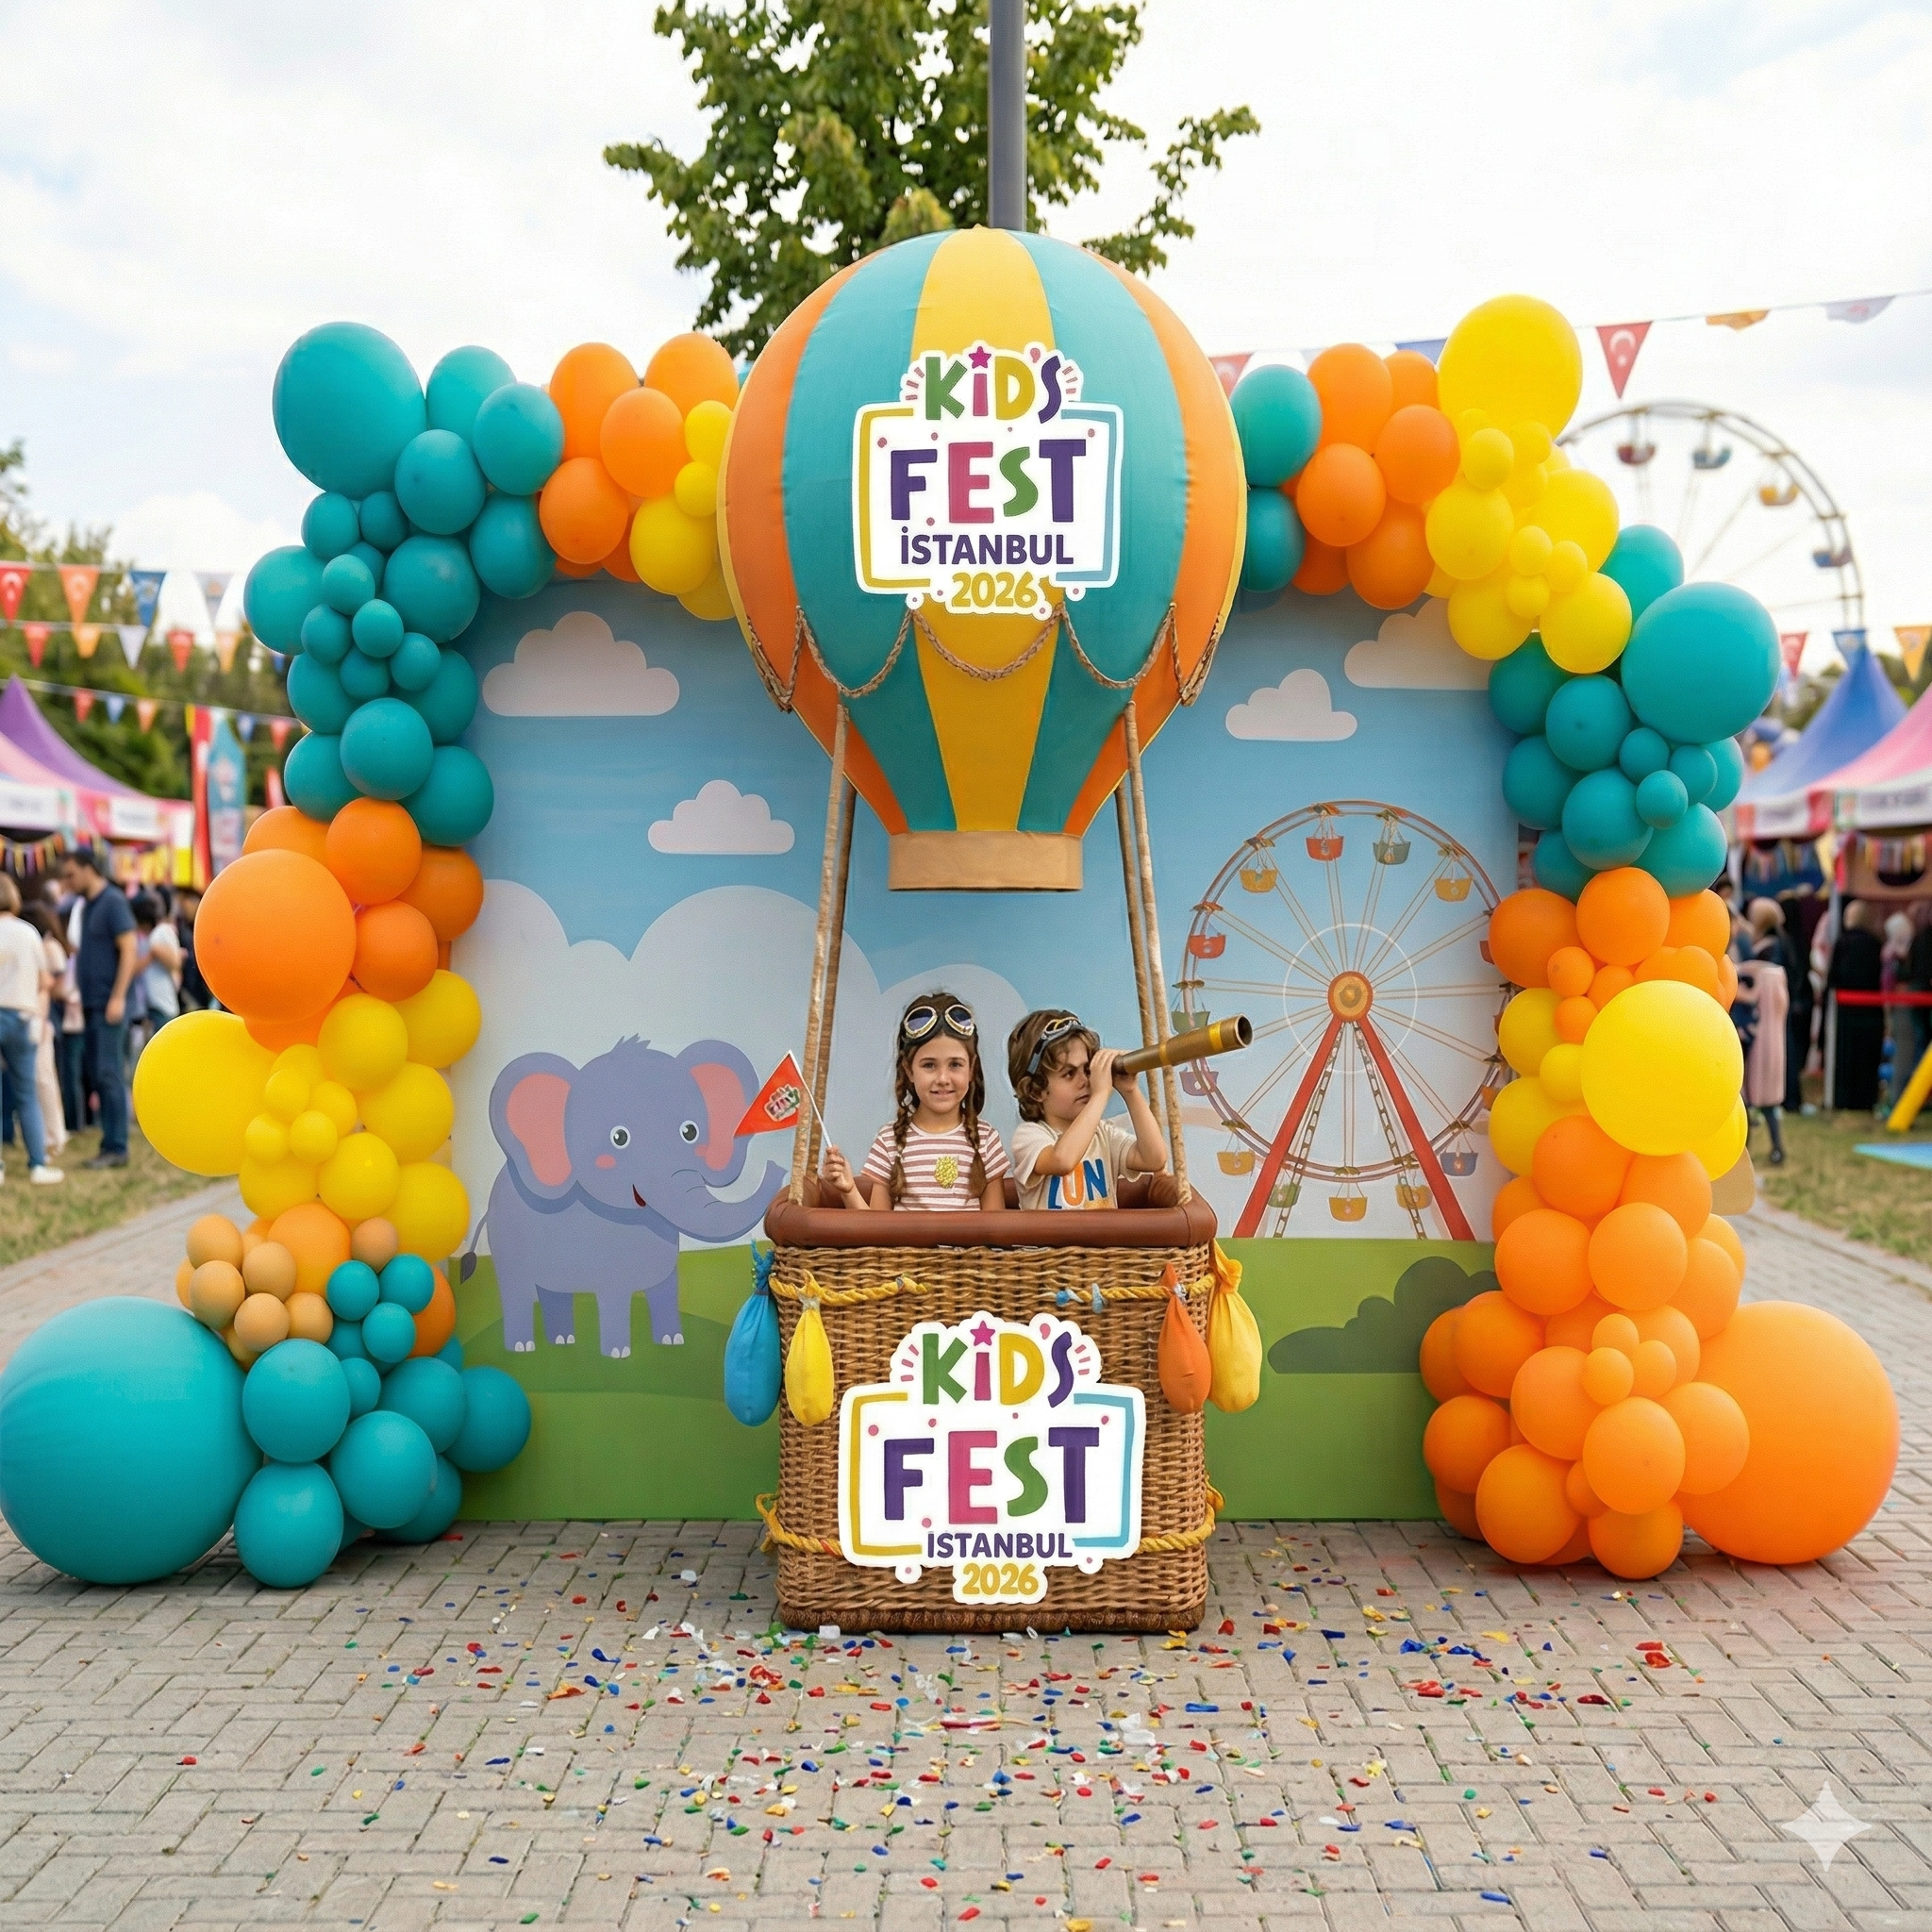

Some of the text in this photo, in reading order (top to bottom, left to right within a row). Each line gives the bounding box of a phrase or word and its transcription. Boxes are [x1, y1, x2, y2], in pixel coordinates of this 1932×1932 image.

[891, 439, 1086, 523] FEST
[901, 526, 1074, 565] İSTANBUL
[952, 571, 1038, 608] 2026
[884, 1427, 1099, 1524] FEST
[962, 1562, 1039, 1595] 2026
